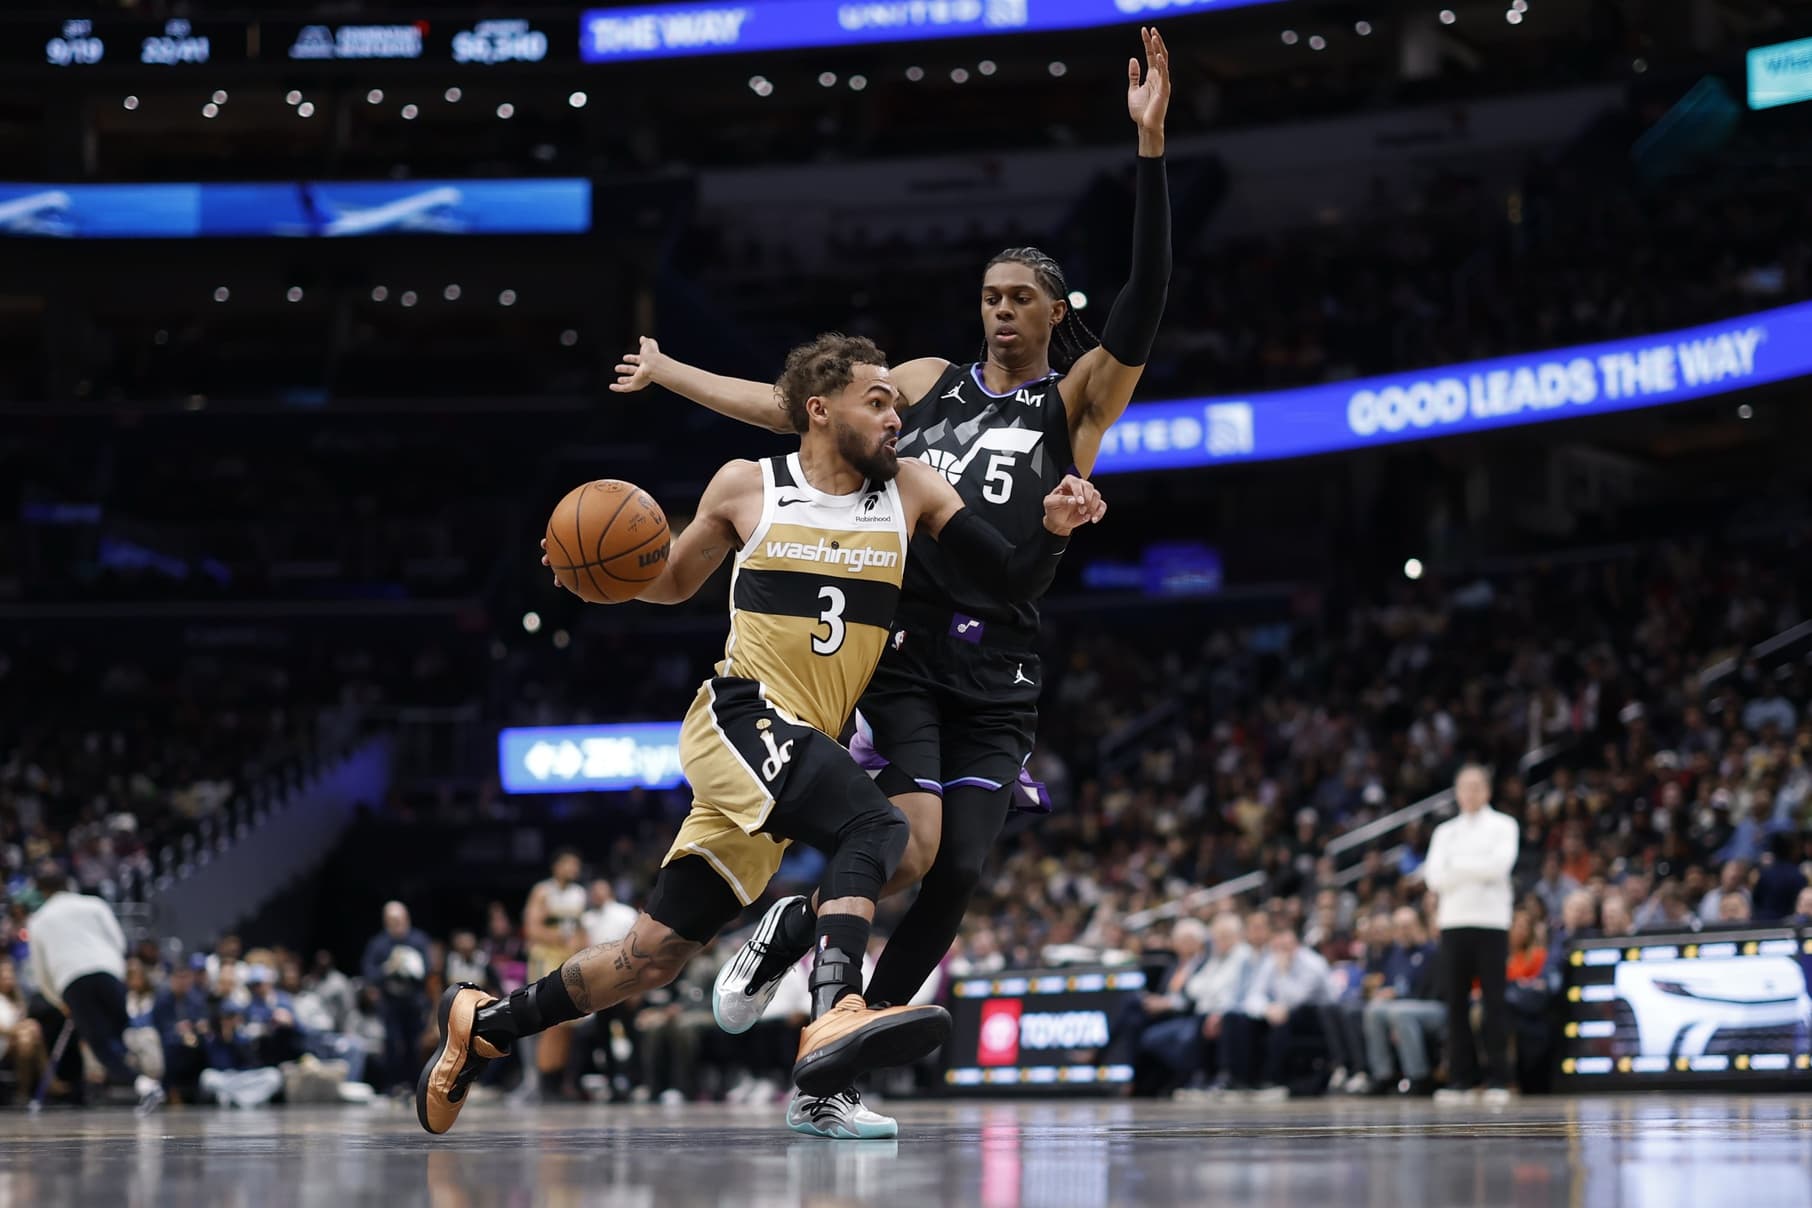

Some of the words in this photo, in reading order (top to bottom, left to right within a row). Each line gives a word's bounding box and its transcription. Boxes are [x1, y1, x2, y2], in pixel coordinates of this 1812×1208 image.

[1347, 378, 1467, 436] GOOD
[1469, 357, 1598, 419] LEADS
[1599, 345, 1677, 400] THE
[1677, 327, 1759, 388] WAY
[1099, 417, 1202, 455] ITED
[982, 454, 1016, 504] 5
[855, 515, 892, 523] Robinhood
[766, 537, 898, 573] washington
[810, 585, 847, 657] 3
[1019, 1010, 1109, 1050] TOYOTA
